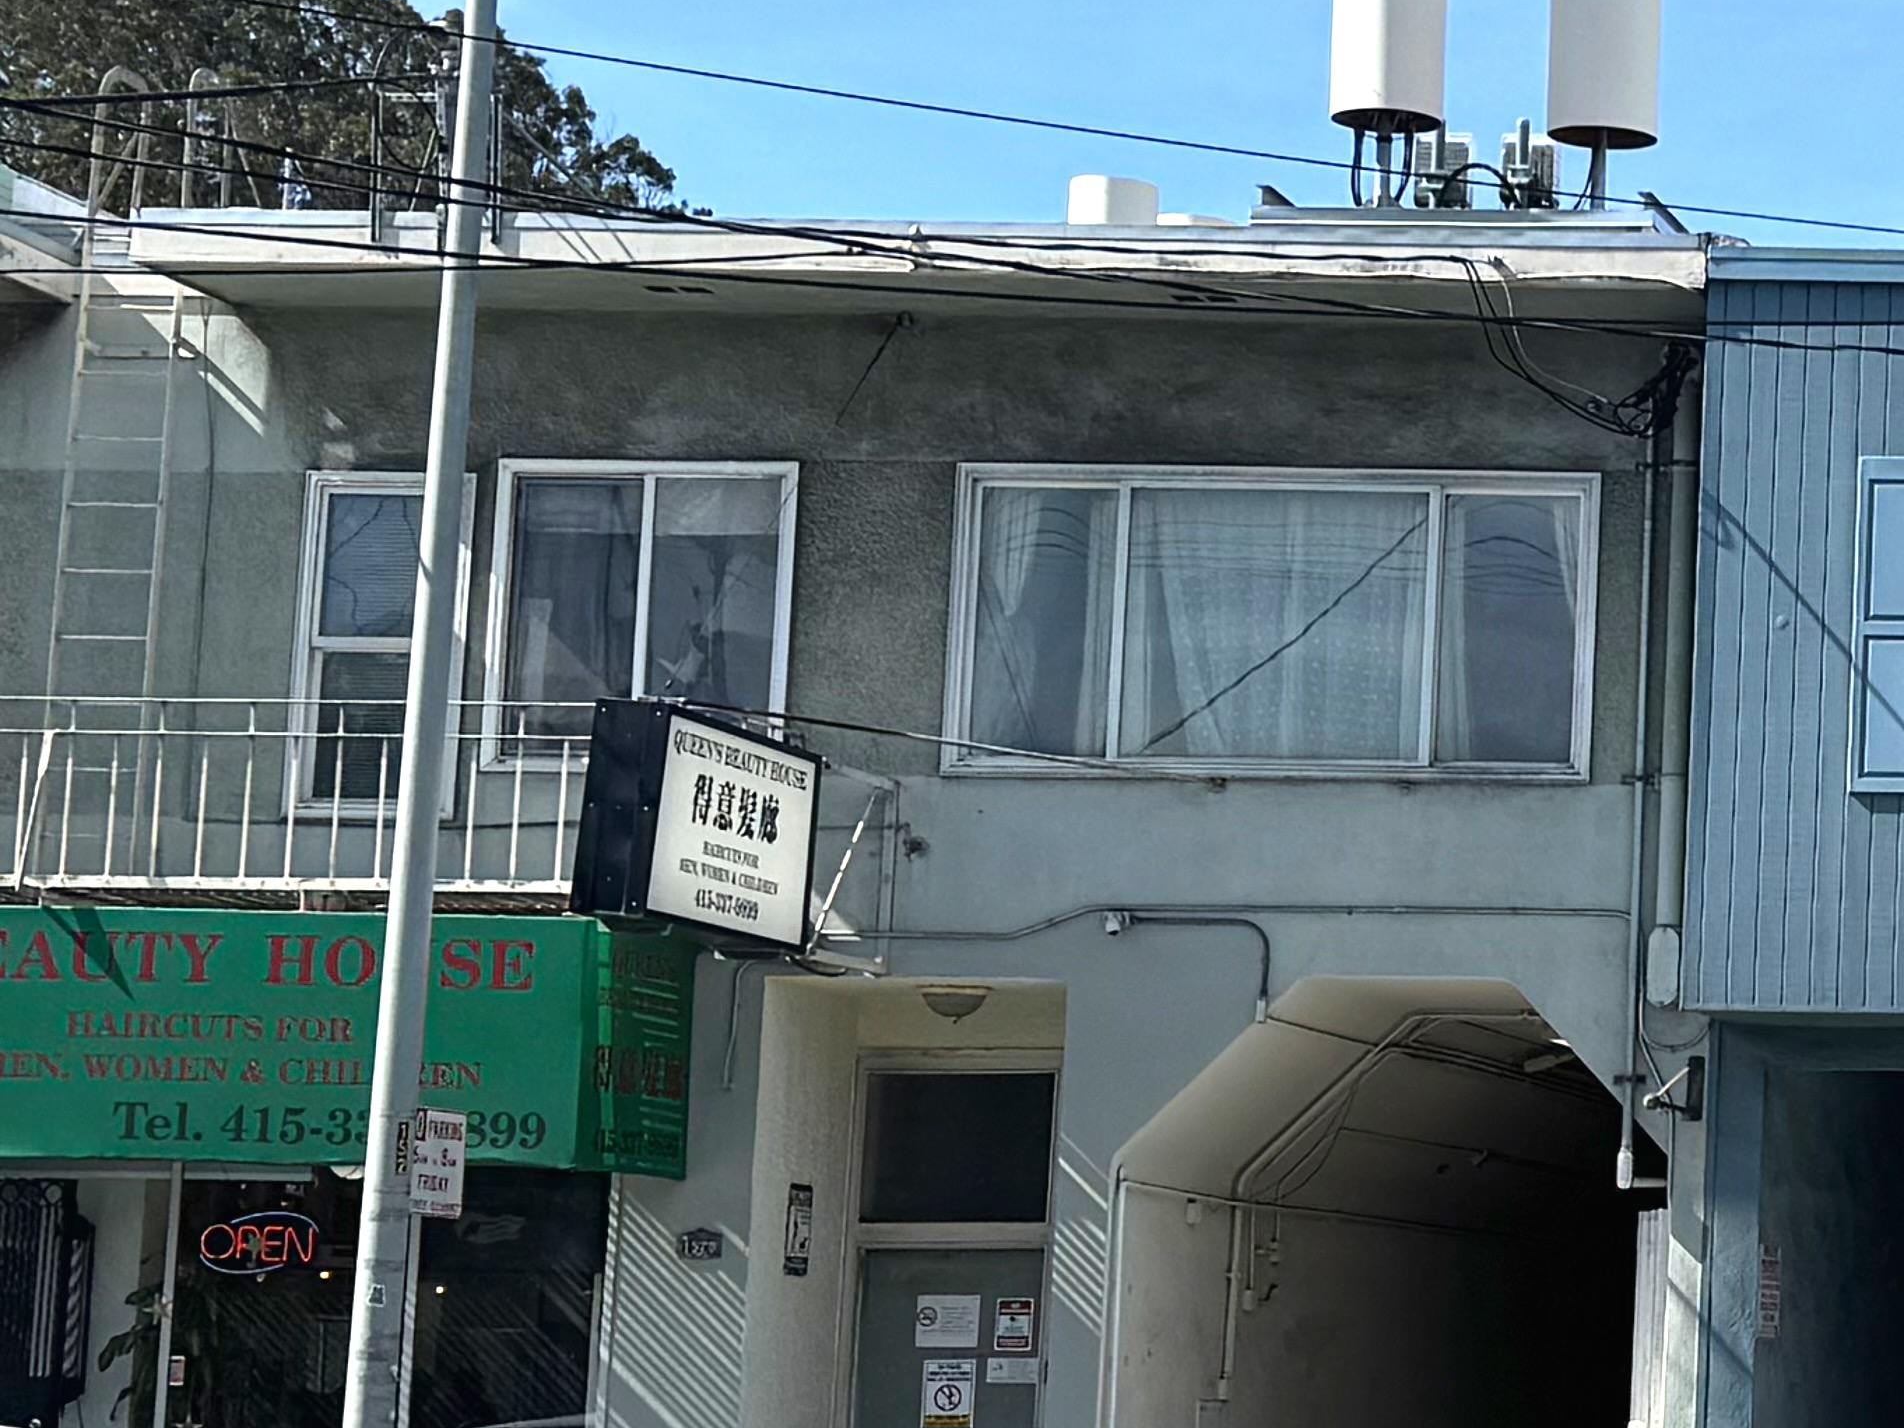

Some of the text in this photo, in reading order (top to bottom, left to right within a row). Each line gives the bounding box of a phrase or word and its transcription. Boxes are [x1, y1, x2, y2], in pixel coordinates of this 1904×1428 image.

[725, 745, 768, 778] BEAUTY
[769, 761, 808, 791] HOUSE
[263, 934, 536, 992] HOSE
[67, 1010, 353, 1043] HAIRCUTS FOR
[83, 1053, 229, 1083] WOMEN
[240, 1058, 266, 1084] &
[279, 1059, 483, 1090] CHILEN
[112, 1101, 204, 1143] Tel.
[220, 1104, 547, 1151] 415-33899
[200, 1224, 314, 1262] OPEN
